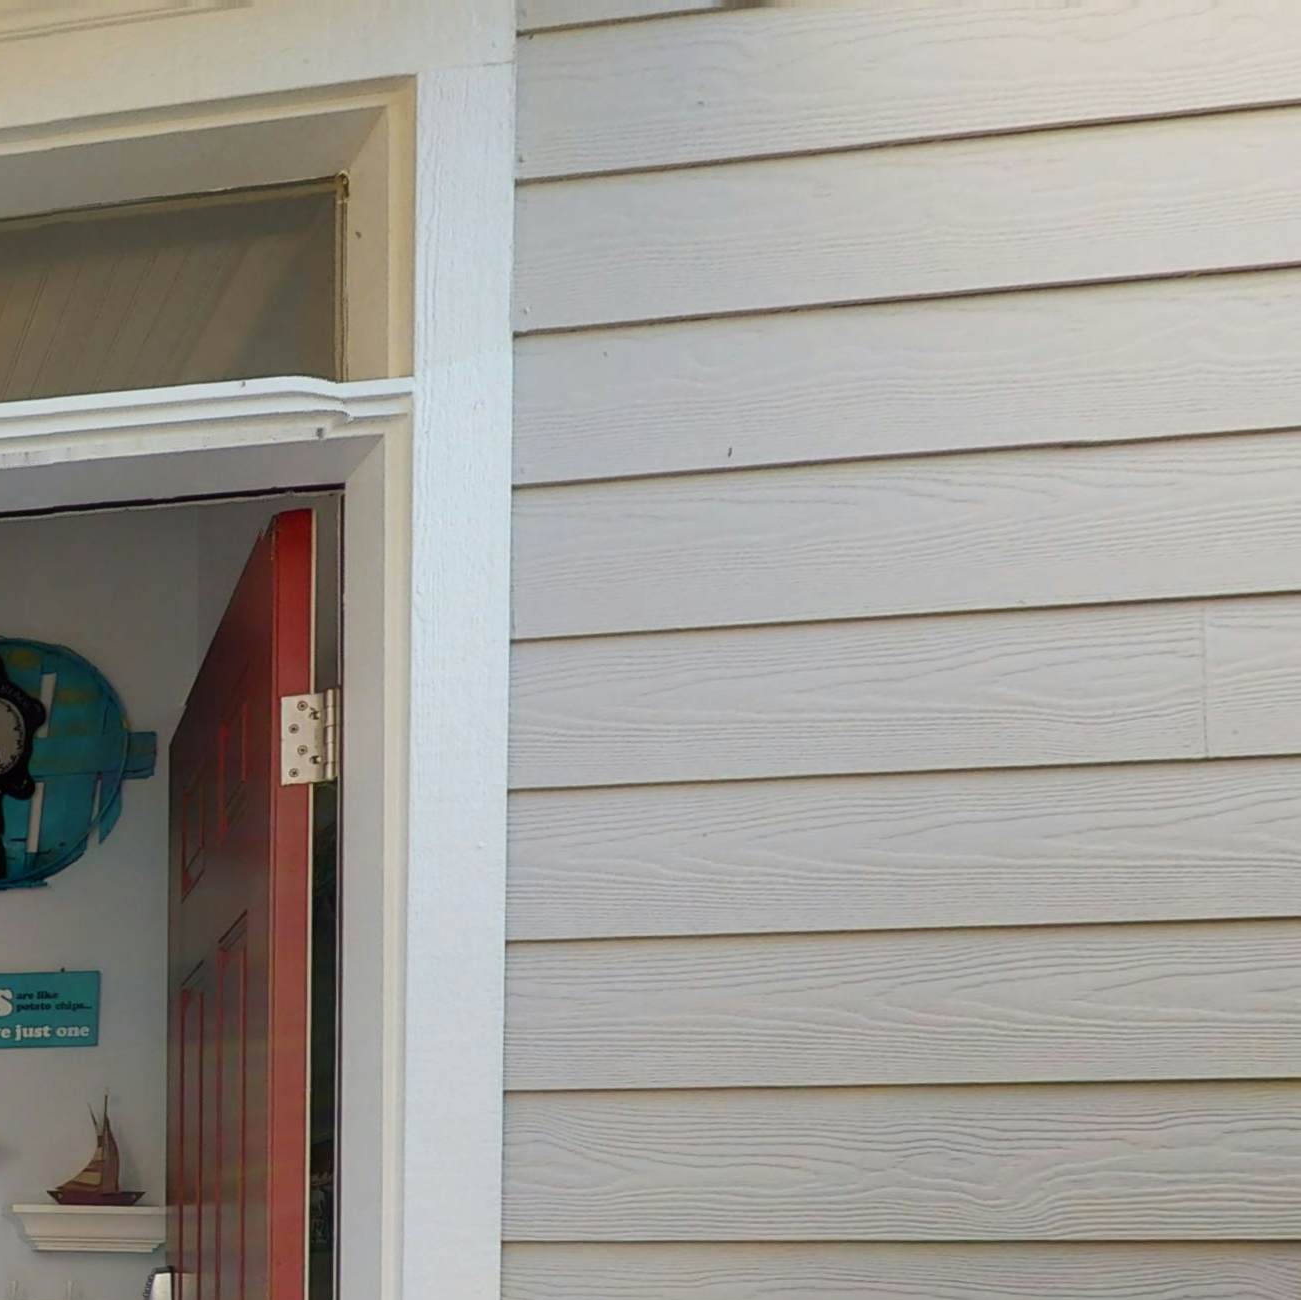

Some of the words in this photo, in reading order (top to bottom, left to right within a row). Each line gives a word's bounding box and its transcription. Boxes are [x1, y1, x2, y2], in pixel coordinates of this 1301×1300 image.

[16, 992, 35, 1000] are
[37, 991, 58, 1000] like
[16, 1002, 52, 1012] potato
[15, 1024, 51, 1041] just
[56, 1026, 90, 1037] one
